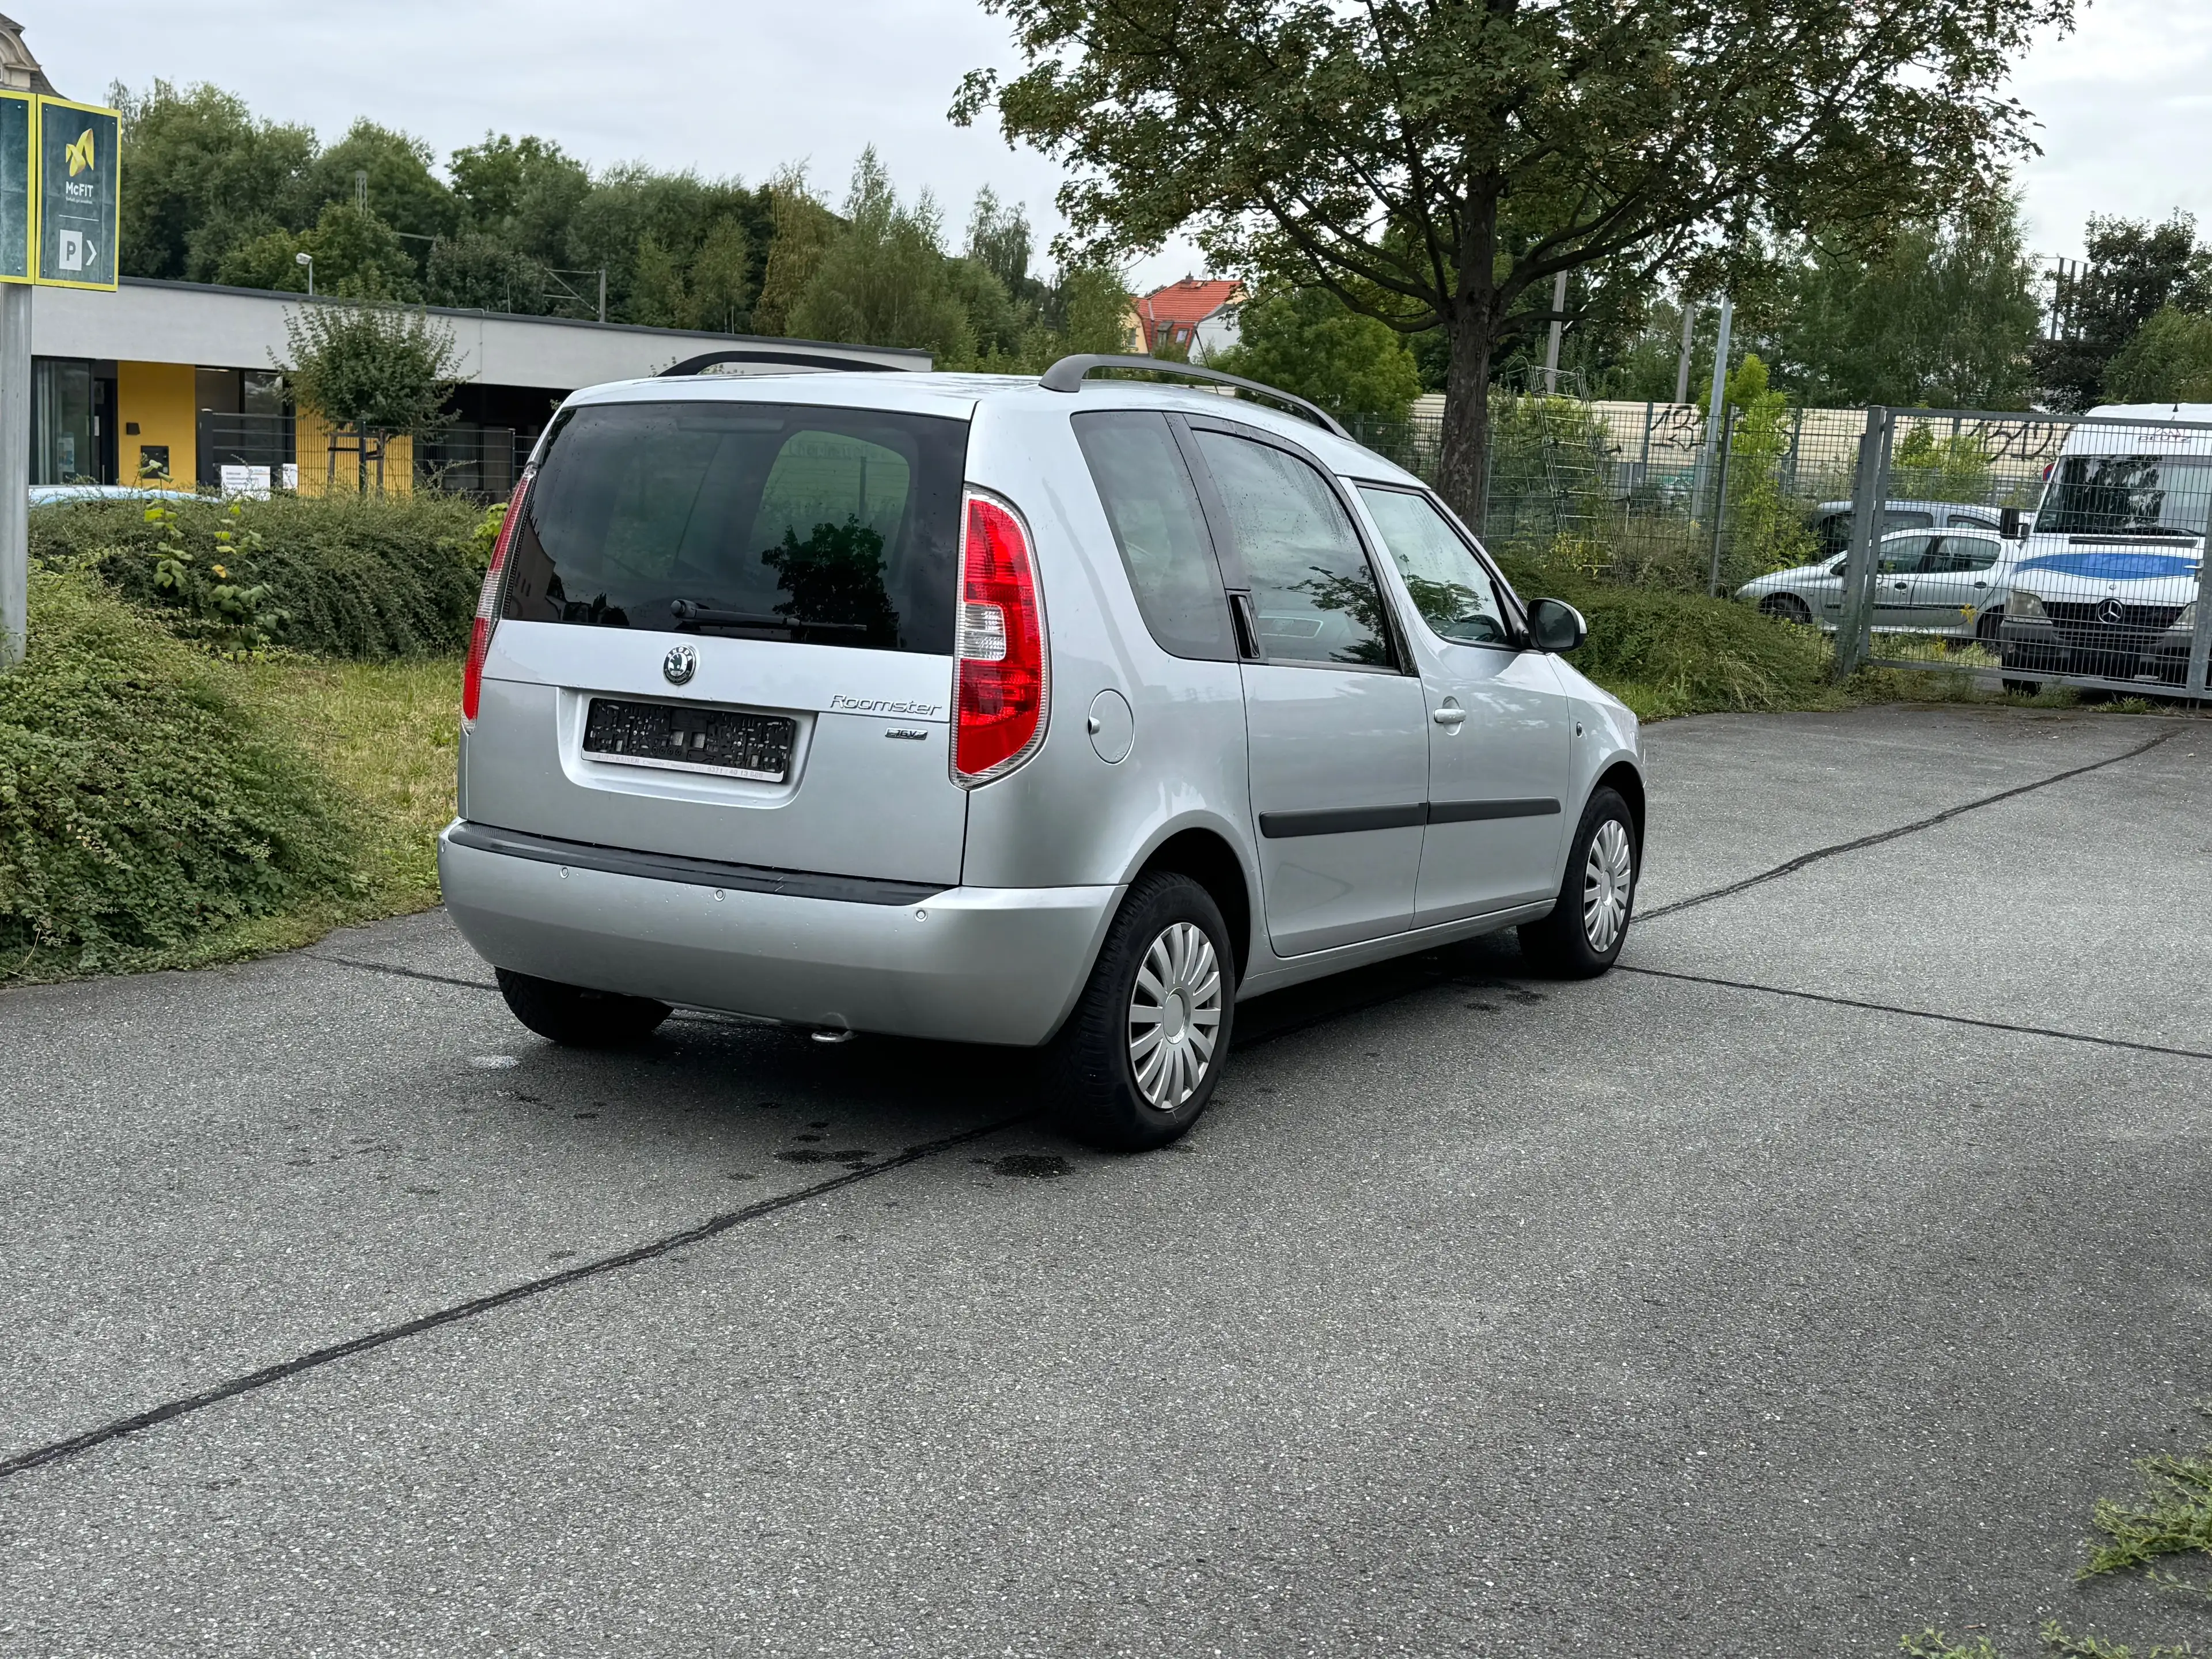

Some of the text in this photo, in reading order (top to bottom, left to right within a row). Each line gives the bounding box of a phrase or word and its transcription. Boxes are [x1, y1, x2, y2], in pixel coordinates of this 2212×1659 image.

[66, 181, 93, 197] McFIT
[66, 241, 76, 261] P
[830, 694, 942, 715] Roomster
[897, 729, 917, 738] 16V
[596, 753, 640, 765] AUTO-KAISER
